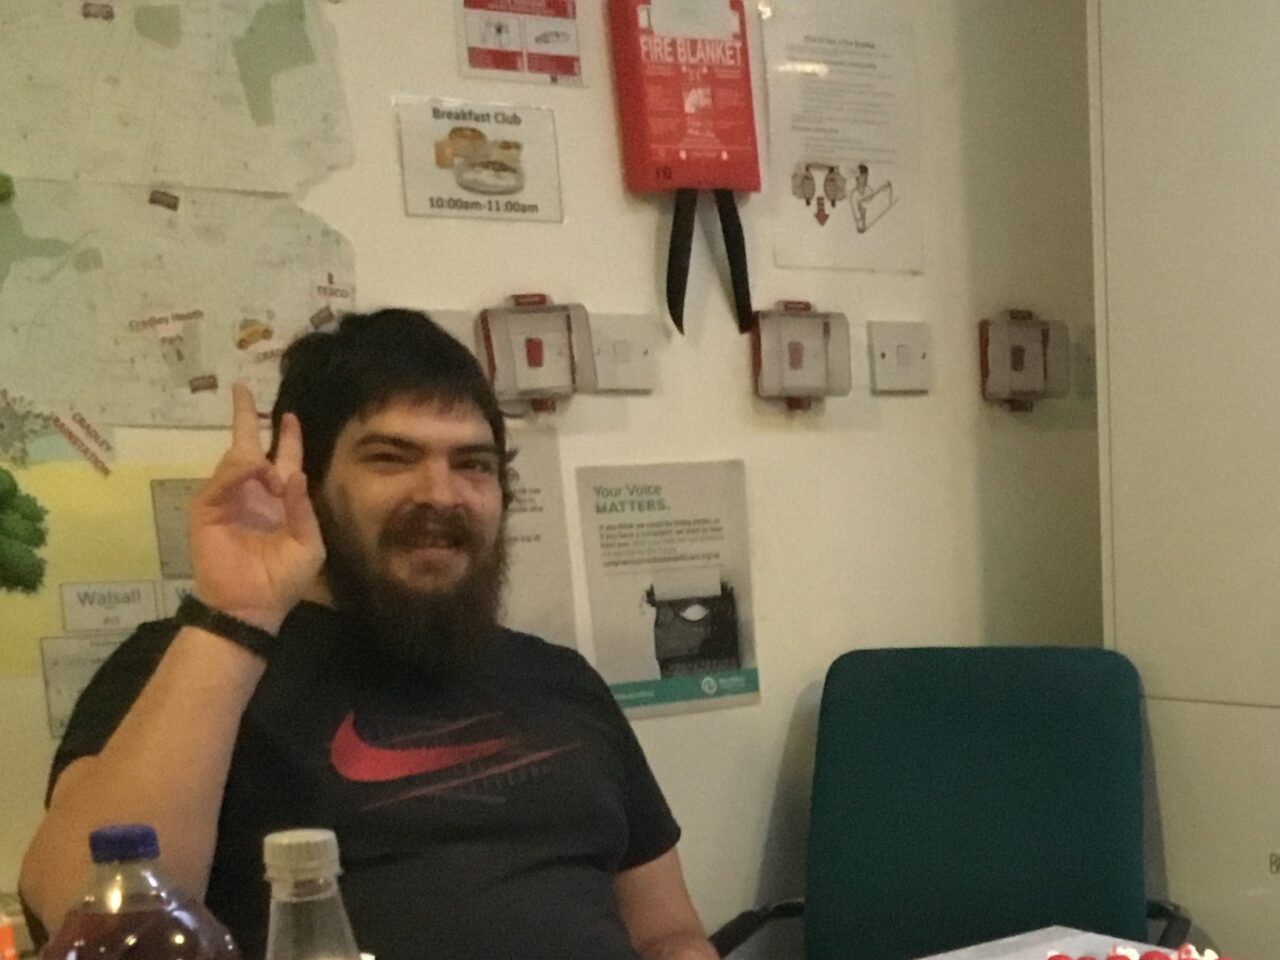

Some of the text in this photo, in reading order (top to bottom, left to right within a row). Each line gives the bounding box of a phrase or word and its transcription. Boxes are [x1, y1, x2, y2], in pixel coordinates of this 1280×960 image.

[640, 37, 742, 66] FIRE BLANKET
[432, 107, 522, 125] Breakfast Club
[592, 484, 662, 498] Your Voice
[595, 498, 671, 514] MATTERS.
[77, 587, 141, 606] Walsall
